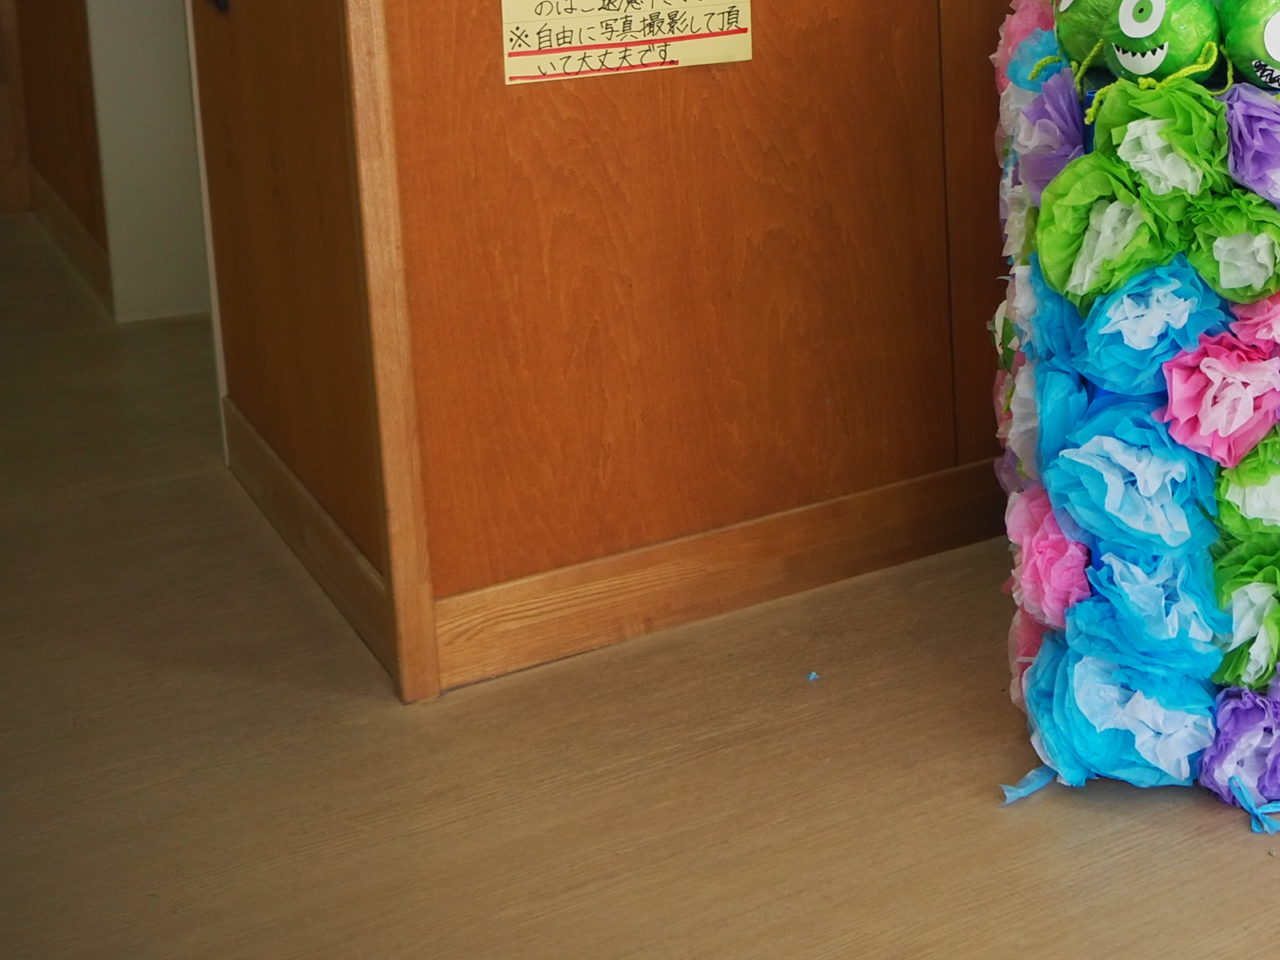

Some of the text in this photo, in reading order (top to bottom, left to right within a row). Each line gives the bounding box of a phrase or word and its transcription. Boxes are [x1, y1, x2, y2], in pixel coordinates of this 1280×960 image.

[537, 42, 676, 76] いて大丈夫です。
